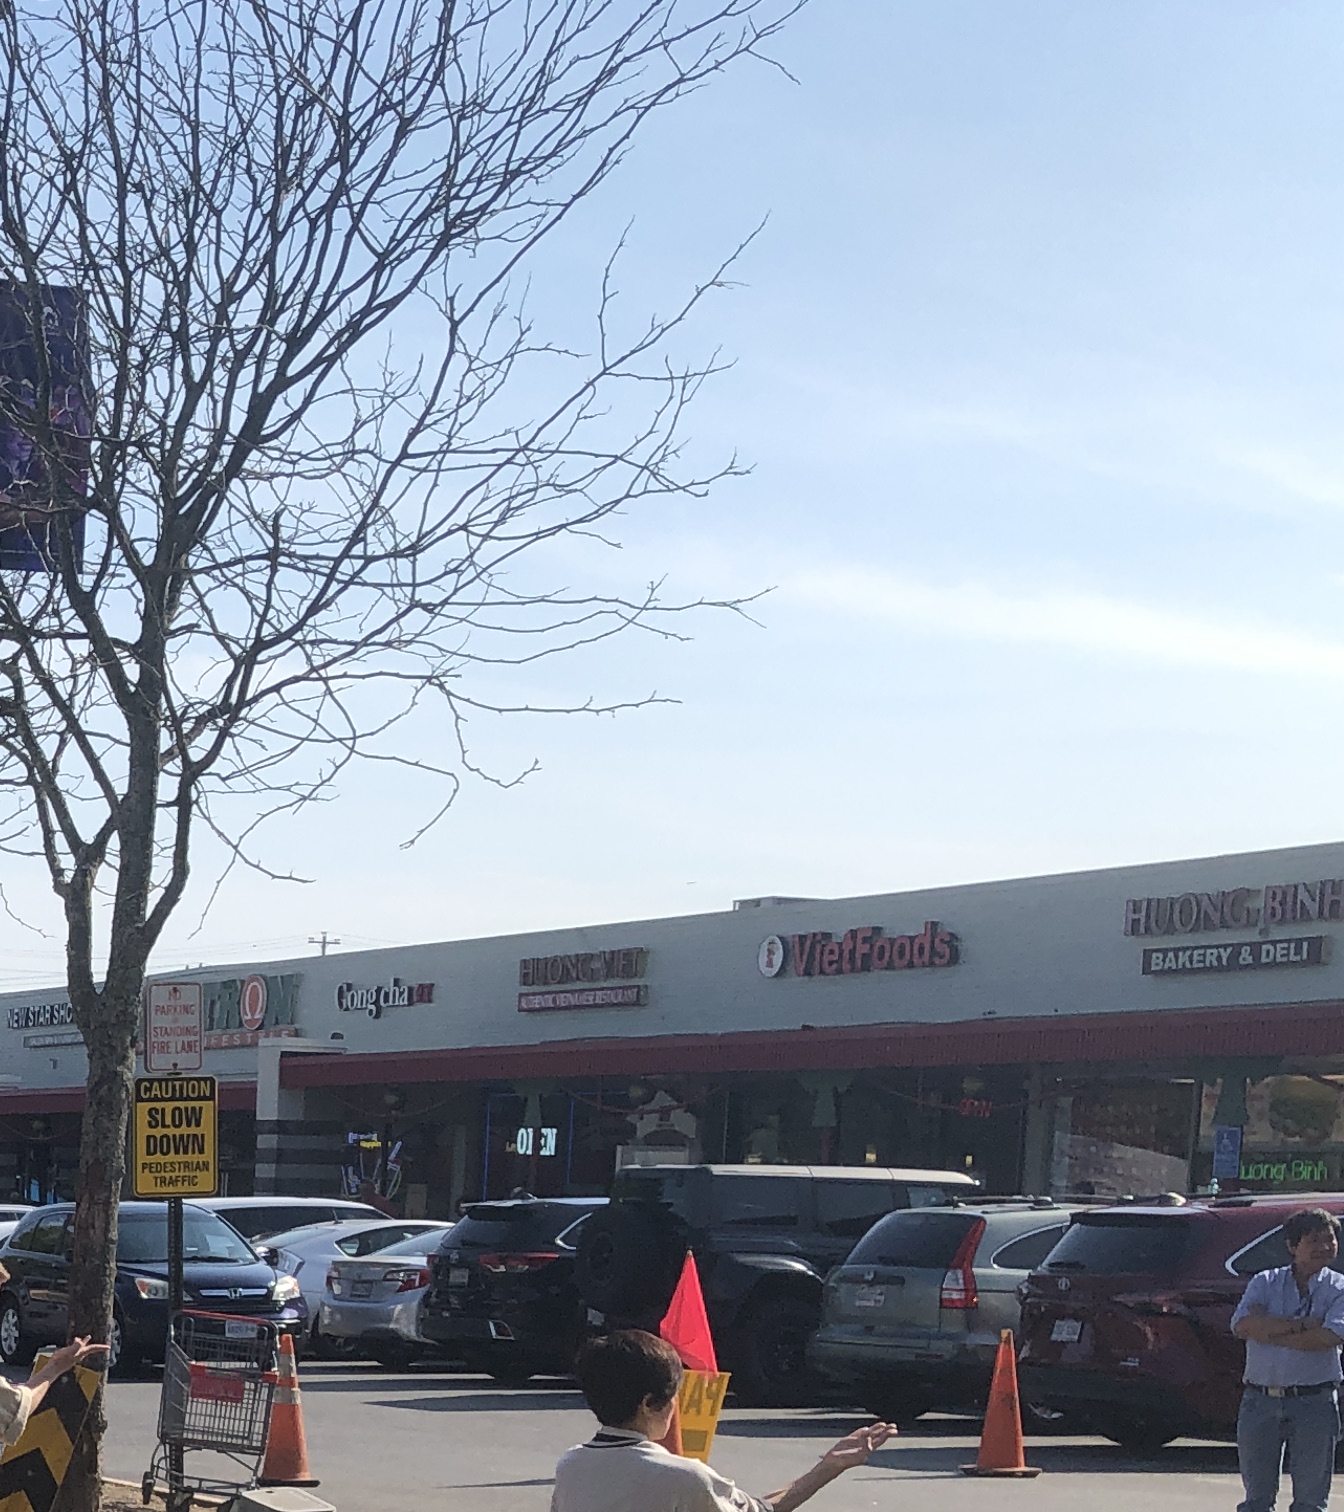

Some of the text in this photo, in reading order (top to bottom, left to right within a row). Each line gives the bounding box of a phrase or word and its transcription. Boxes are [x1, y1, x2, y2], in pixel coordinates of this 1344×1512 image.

[793, 919, 955, 977] VietFoods
[1150, 941, 1309, 971] BAKERY & DELI
[168, 989, 182, 1001] NO
[335, 982, 378, 1018] Gong
[379, 978, 409, 1007] cha
[7, 1008, 27, 1028] NEW
[28, 1005, 51, 1027] STAR
[155, 1004, 196, 1017] PARKING
[153, 1026, 199, 1038] STANDING
[152, 1041, 172, 1055] FIRE
[175, 1040, 199, 1054] LANE
[140, 1080, 210, 1099] CAUTION
[147, 1106, 203, 1129] SLOW
[146, 1133, 205, 1156] DOWN
[141, 1160, 210, 1174] PEDESTRIAN
[153, 1175, 199, 1188] TRAFFIC
